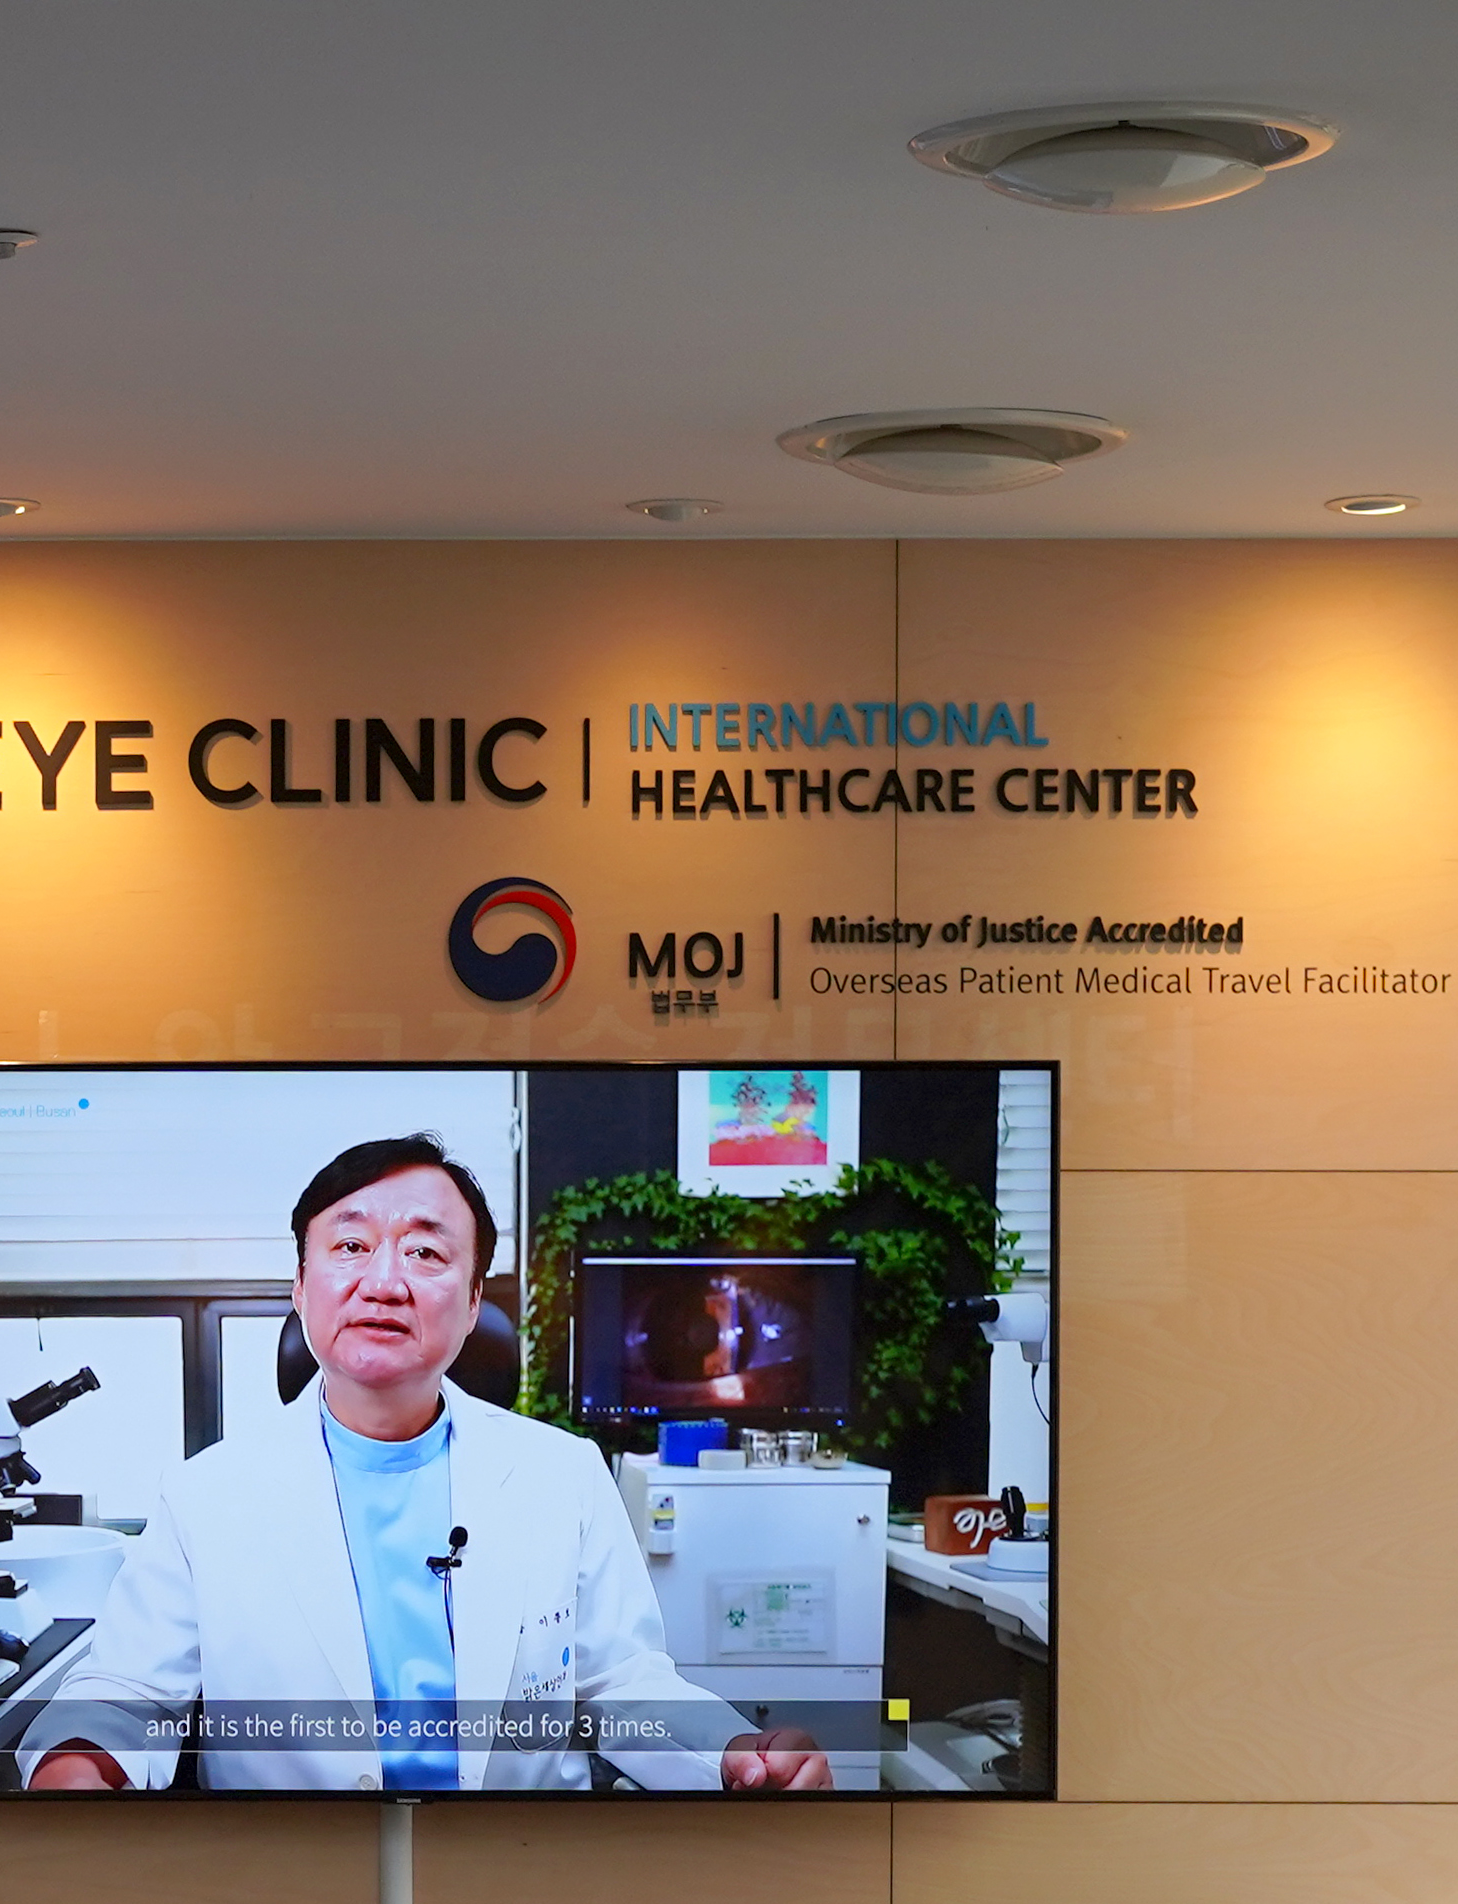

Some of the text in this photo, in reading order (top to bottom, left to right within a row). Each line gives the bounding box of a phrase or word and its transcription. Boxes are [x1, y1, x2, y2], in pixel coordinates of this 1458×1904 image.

[629, 701, 1050, 752] INTERNATIONAL
[187, 716, 549, 807] CLINIC
[631, 767, 1199, 819] HEALTHCARE CENTER
[628, 932, 745, 983] MOJ
[810, 916, 1245, 954] Ministry of Justice Accredited
[810, 967, 1452, 996] Overseas Patient Medical Travel Facilitator
[146, 1711, 672, 1739] and it is the first to be accredited for 3 times.
